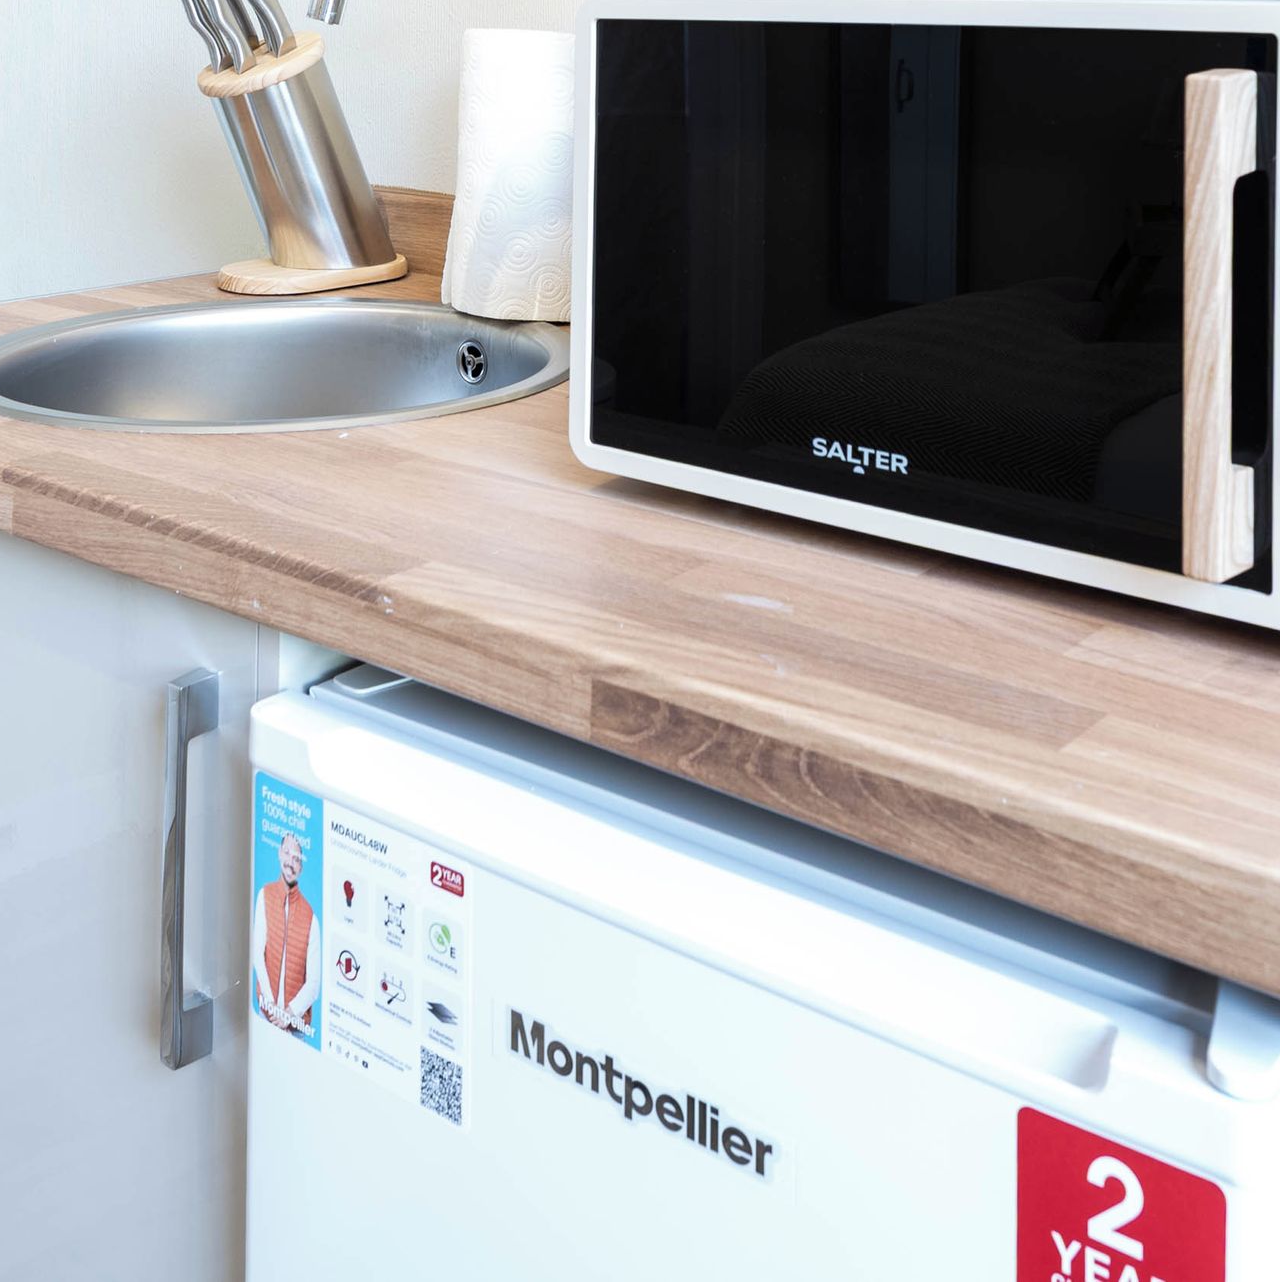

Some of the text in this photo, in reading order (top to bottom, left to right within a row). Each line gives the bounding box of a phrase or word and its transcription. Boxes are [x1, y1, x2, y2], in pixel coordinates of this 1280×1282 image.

[812, 437, 909, 475] SALTER
[262, 784, 312, 820] Fresh style
[263, 800, 288, 823] 100%
[432, 864, 443, 887] 2
[442, 867, 462, 886] YEAR
[259, 994, 316, 1039] Montpellier
[510, 1008, 773, 1177] Montpellier
[1086, 1155, 1145, 1262] 2
[1050, 1229, 1168, 1282] YE
